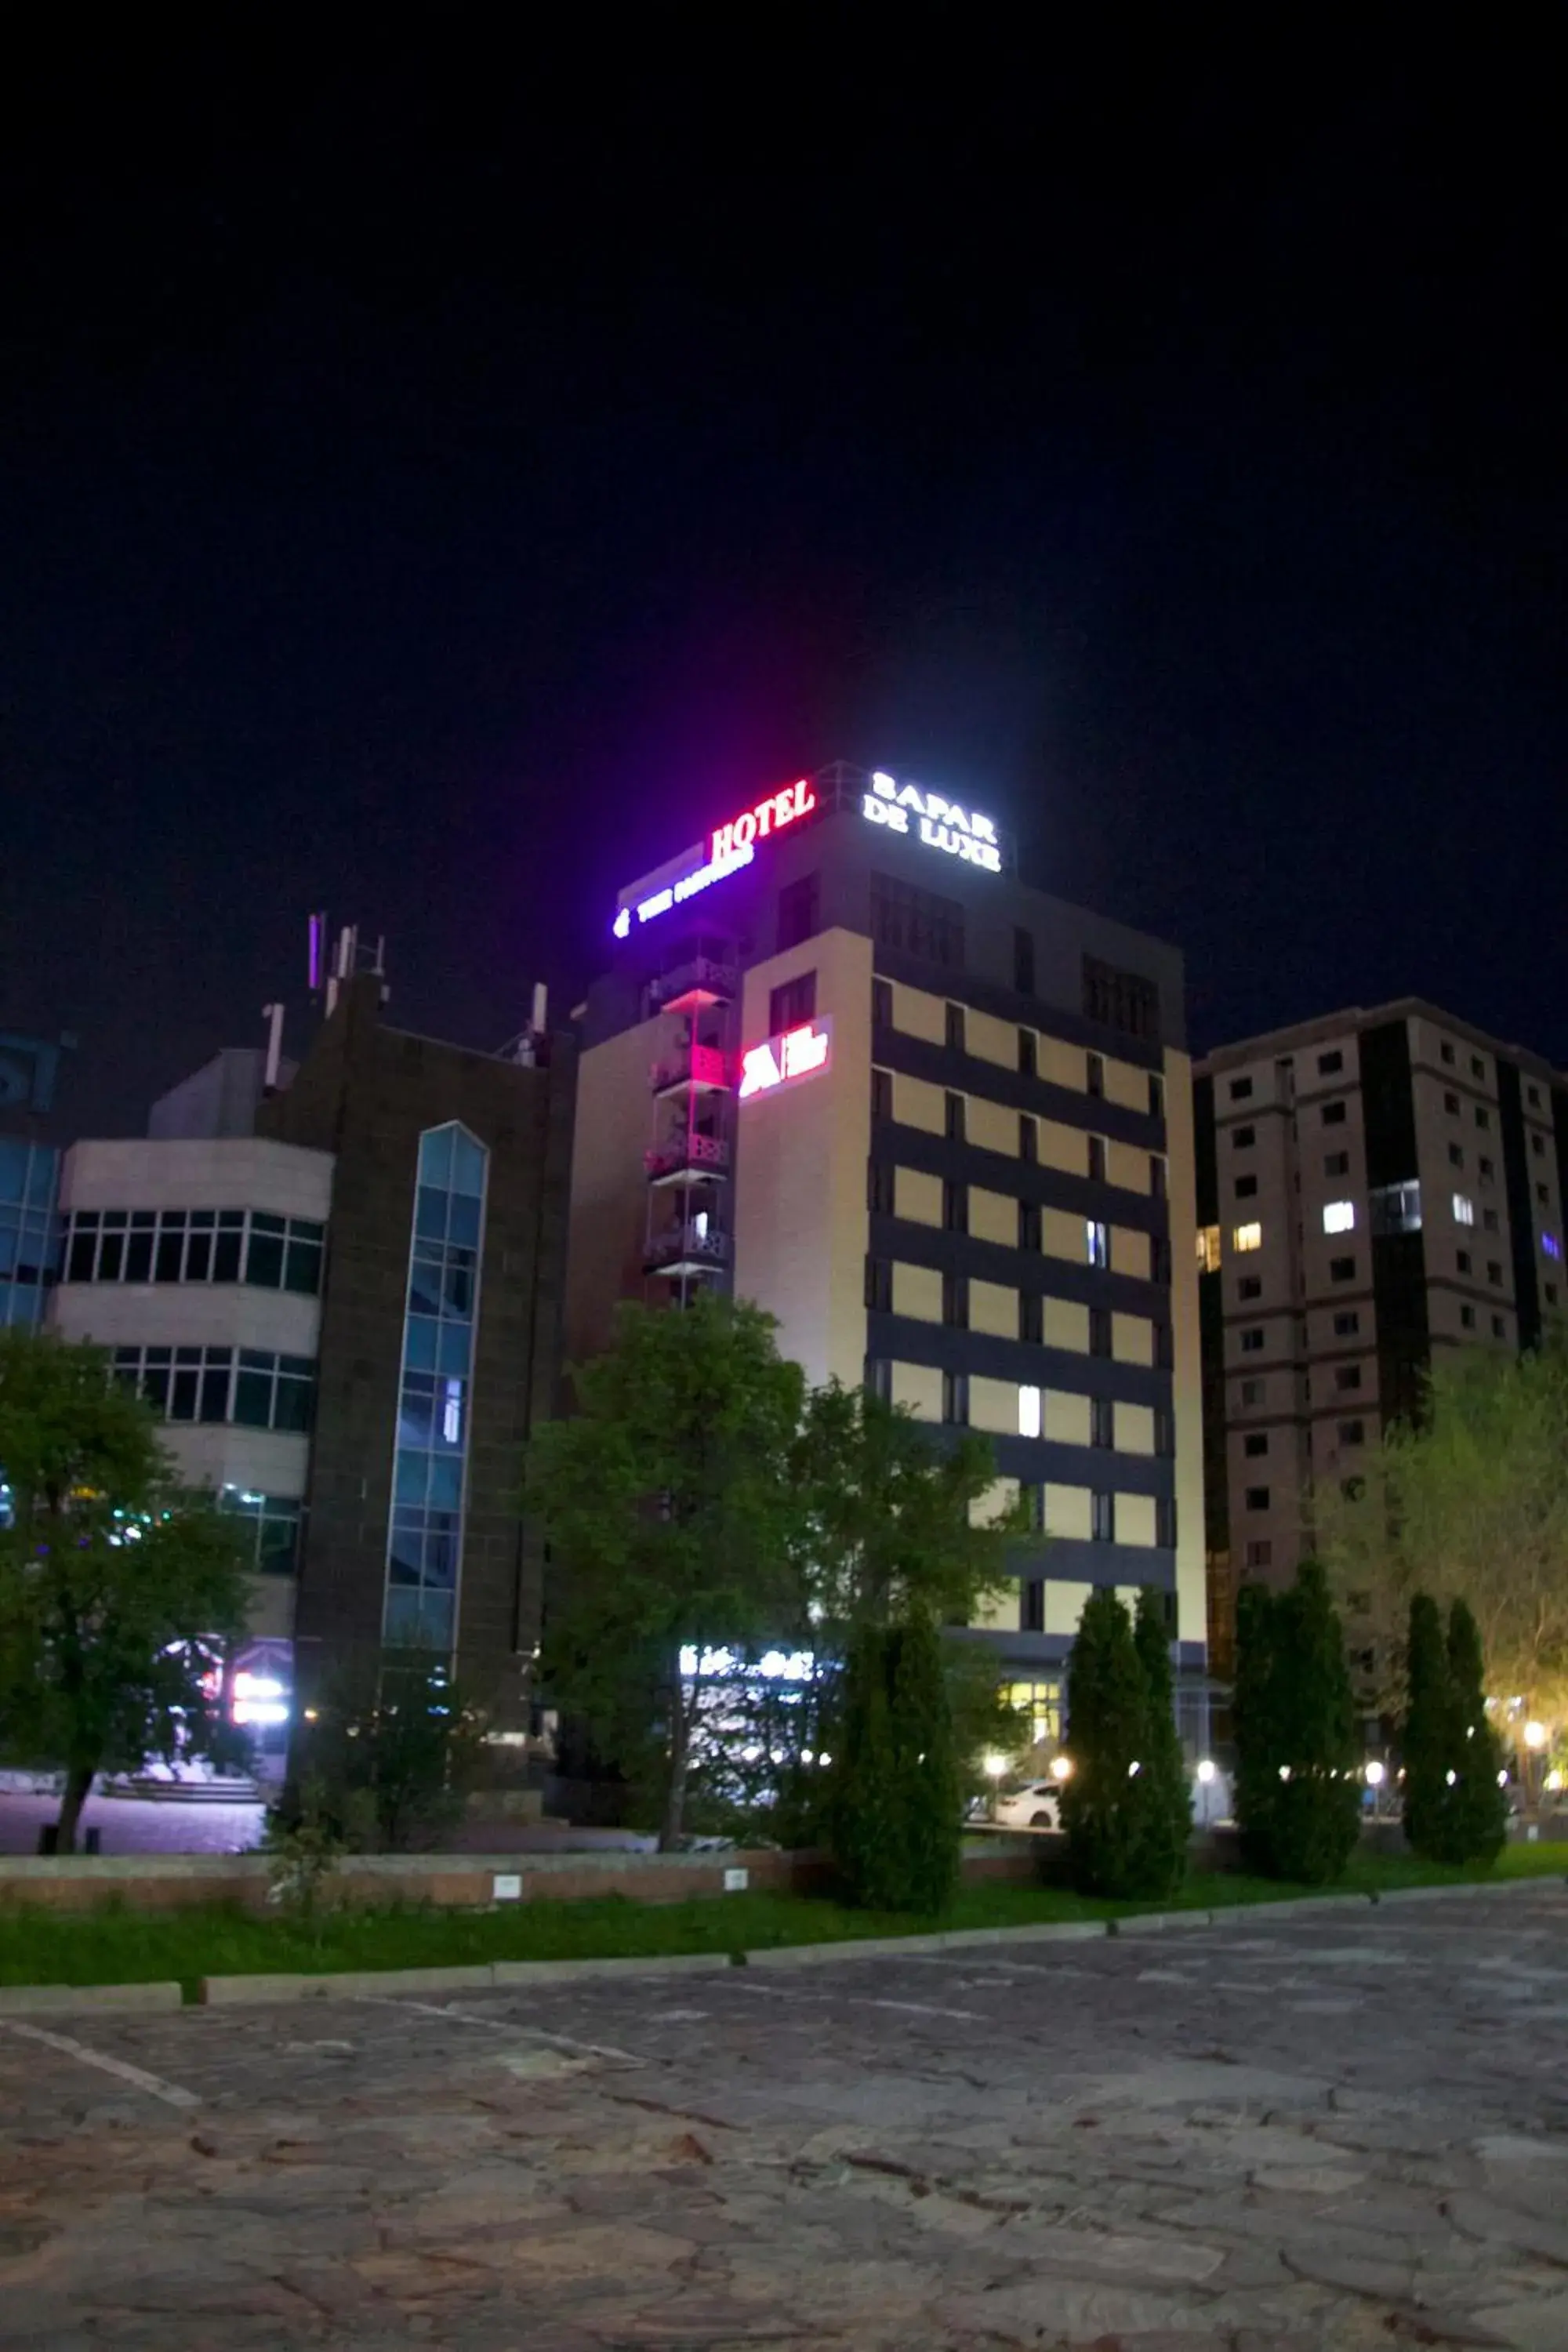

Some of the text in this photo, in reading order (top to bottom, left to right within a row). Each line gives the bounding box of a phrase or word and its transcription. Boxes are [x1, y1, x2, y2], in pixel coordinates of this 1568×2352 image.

[711, 779, 815, 866] HOTEL
[863, 793, 1002, 873] DE LUXE
